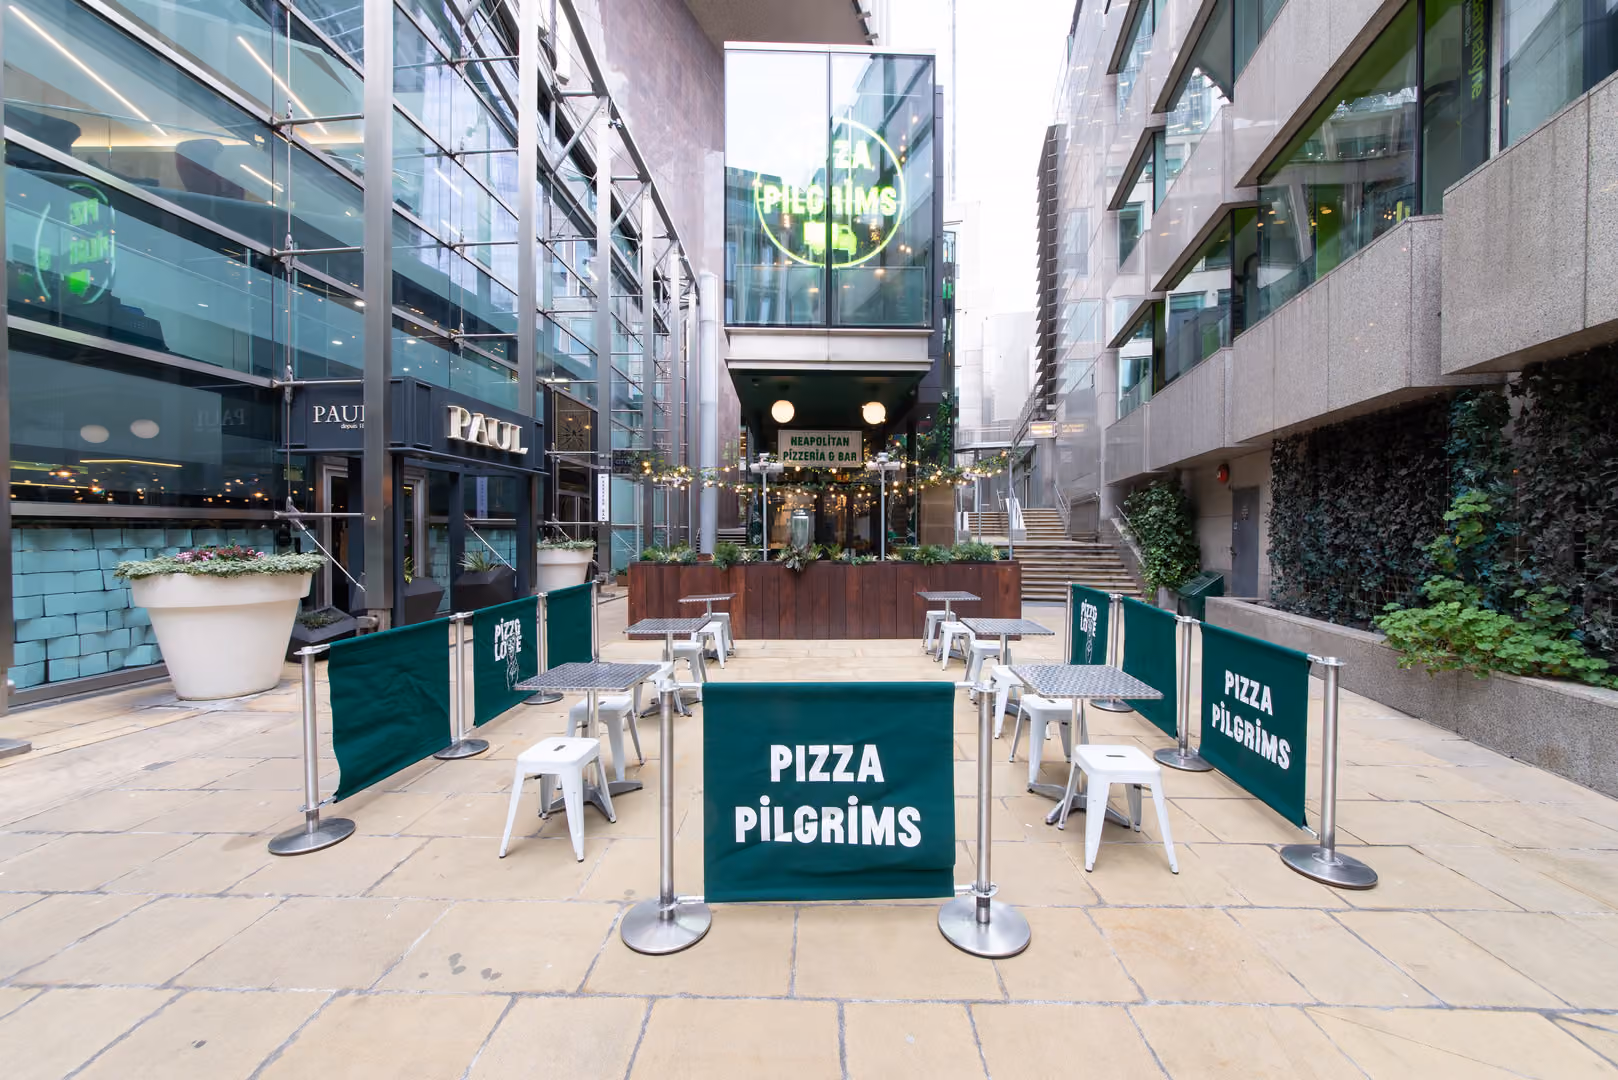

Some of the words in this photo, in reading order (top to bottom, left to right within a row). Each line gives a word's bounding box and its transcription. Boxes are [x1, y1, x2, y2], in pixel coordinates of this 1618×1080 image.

[446, 405, 529, 455] PAUL
[838, 452, 857, 462] BAR
[1079, 616, 1098, 638] LOE
[494, 634, 523, 662] LOE
[1224, 669, 1274, 716] PIZZA
[770, 744, 885, 782] PIZZA
